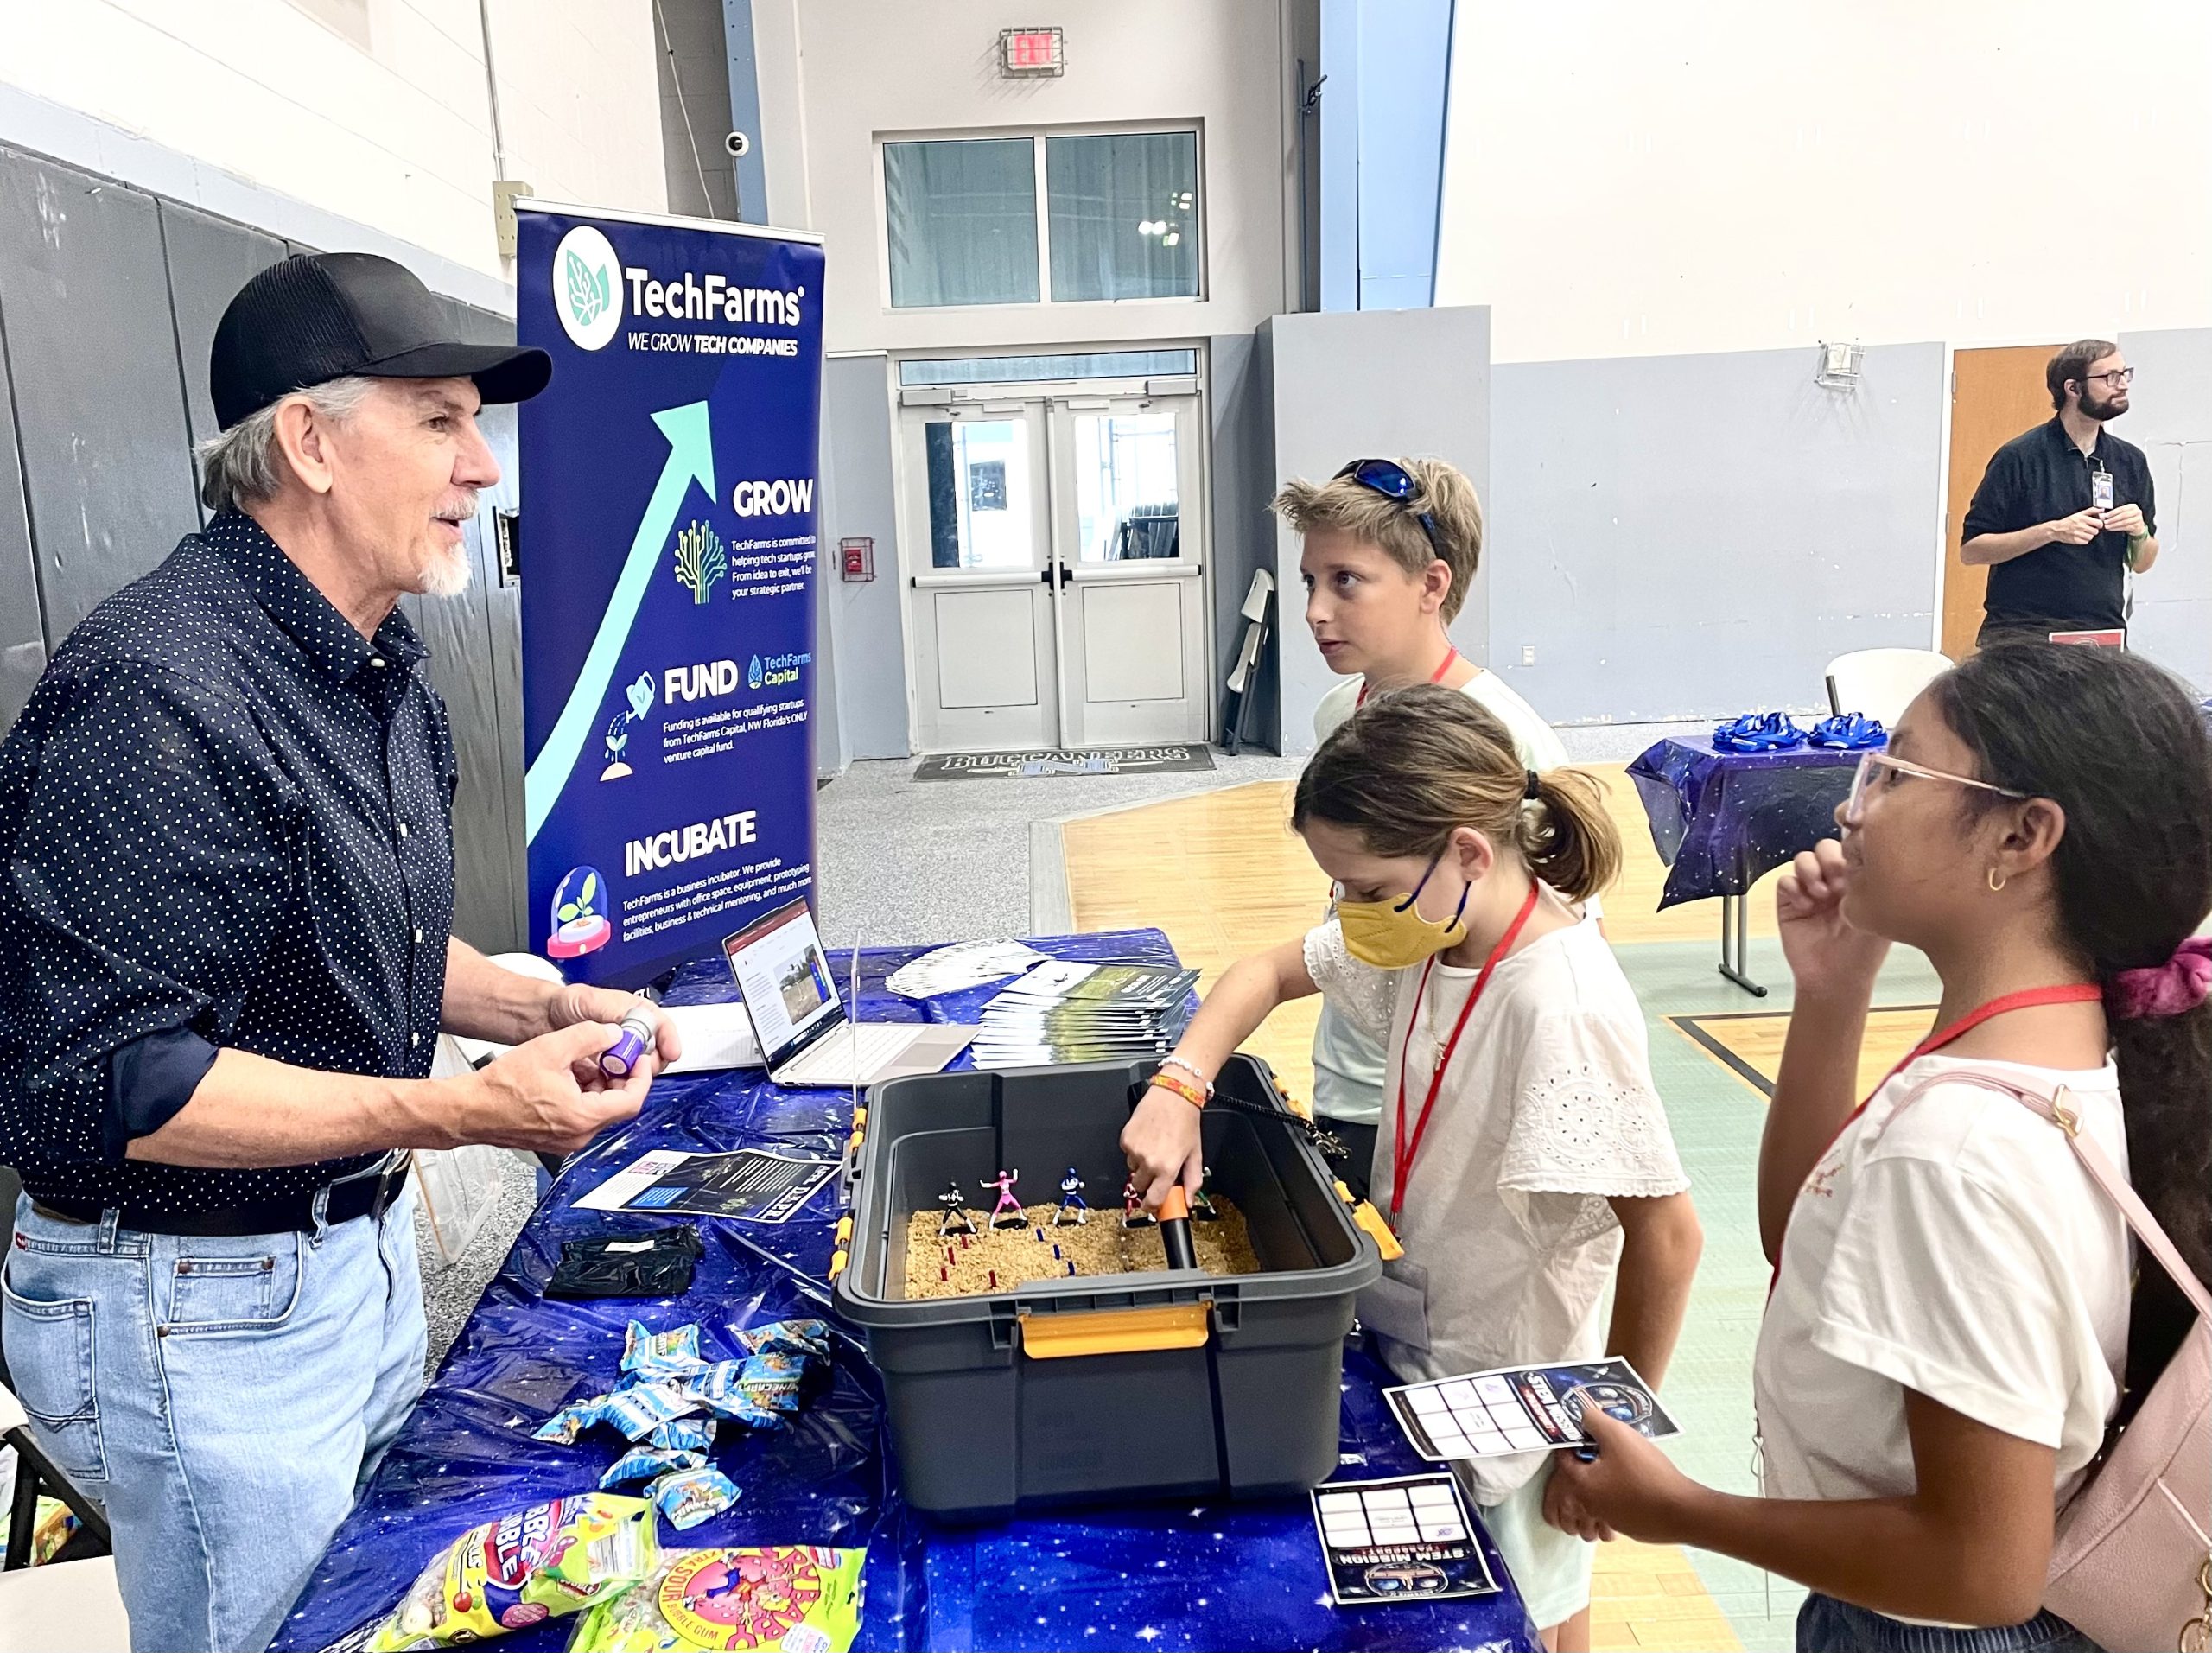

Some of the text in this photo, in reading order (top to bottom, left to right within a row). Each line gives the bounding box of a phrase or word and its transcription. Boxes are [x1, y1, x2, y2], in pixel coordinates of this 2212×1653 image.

[626, 267, 801, 327] TechFarms
[628, 332, 798, 357] WE GROW TECH COMPANIES
[733, 479, 813, 518] GROW
[731, 538, 772, 550] TechFarms
[772, 537, 778, 548] is
[779, 535, 810, 548] committed
[732, 555, 760, 568] helping
[760, 554, 776, 564] tech
[777, 552, 803, 563] startups
[732, 571, 752, 582] From
[753, 569, 768, 580] idea
[769, 569, 778, 579] to
[732, 588, 748, 600] your
[749, 582, 779, 596] strategic
[764, 652, 811, 670] TechFarms
[764, 667, 798, 685] Capital
[664, 659, 738, 704] FUND
[663, 699, 804, 733] Funding is available for qualifying startups
[663, 711, 808, 748] from TechFarms Capital, NW Florida's ONLY
[664, 750, 691, 764] venture
[692, 743, 715, 758] capital
[625, 810, 757, 877] INCUBATE
[623, 857, 781, 912] TechFarms is a business incubator. We provide
[623, 863, 810, 927] entrepreneurs with office space, equipment, prototyping
[623, 925, 654, 942] facilities,
[655, 917, 687, 932] business
[687, 912, 693, 922] &
[693, 901, 724, 919] technical
[725, 892, 763, 910] mentoring,
[763, 887, 777, 899] and
[777, 881, 797, 894] much
[1341, 1548, 1465, 1565] STEM MISSION
[662, 1548, 726, 1603] XTRA SOUR
[667, 1603, 719, 1640] BUBBLE GUM
